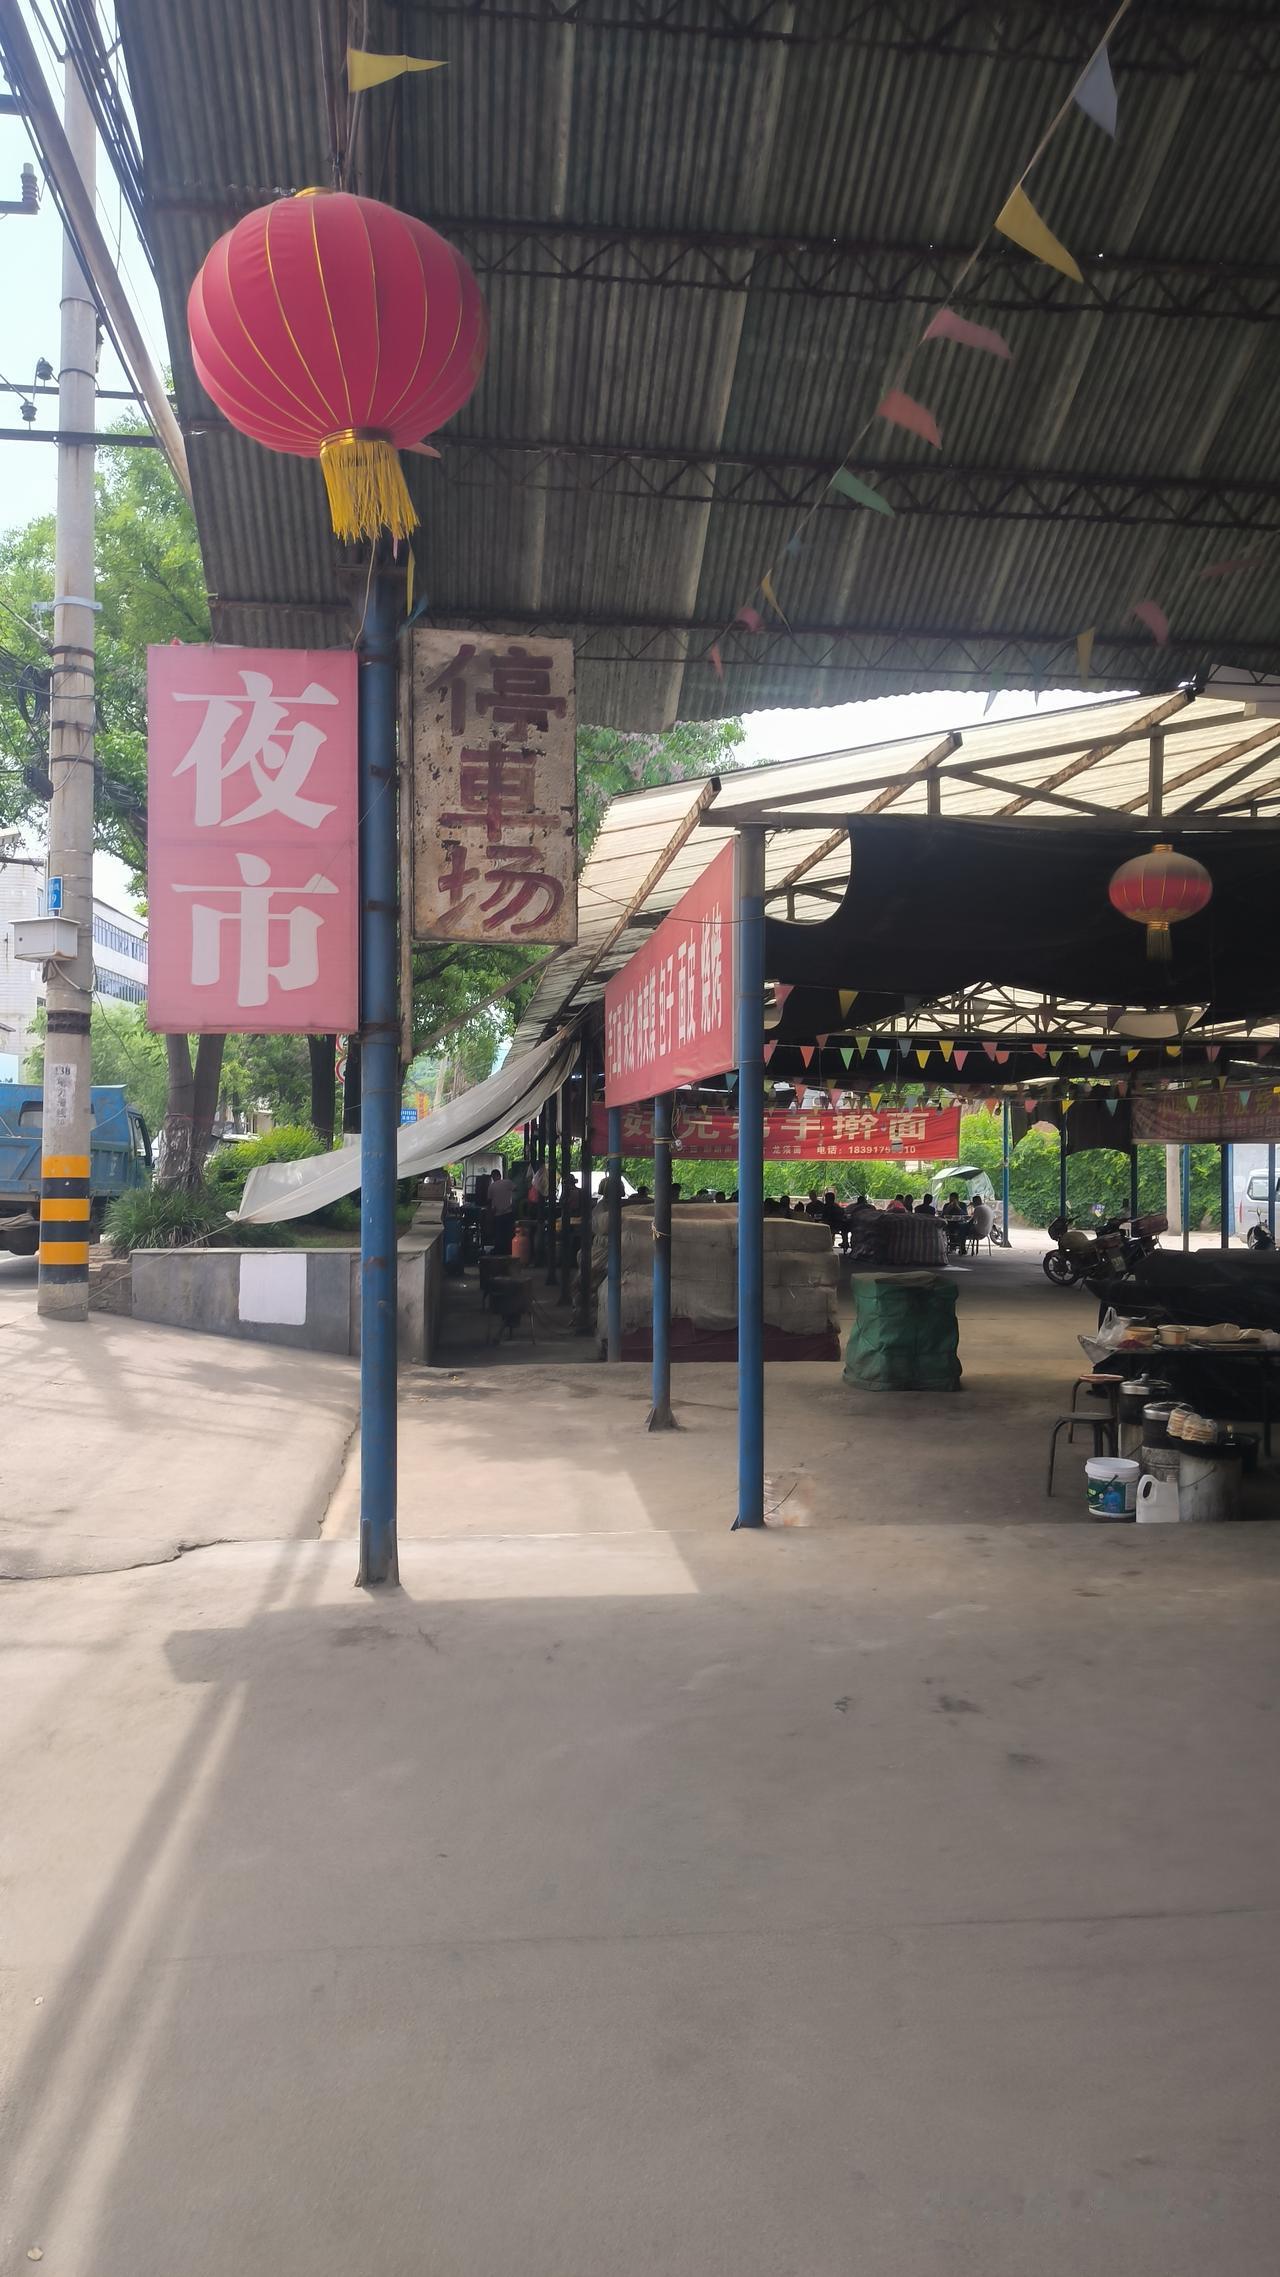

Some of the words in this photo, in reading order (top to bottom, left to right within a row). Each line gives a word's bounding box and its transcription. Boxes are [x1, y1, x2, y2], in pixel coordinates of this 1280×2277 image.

[171, 670, 340, 1008] 夜市
[425, 643, 567, 935] 停車场
[659, 953, 675, 1057] 包子
[678, 927, 696, 1048] 面皮
[701, 901, 723, 1036] 烧烤
